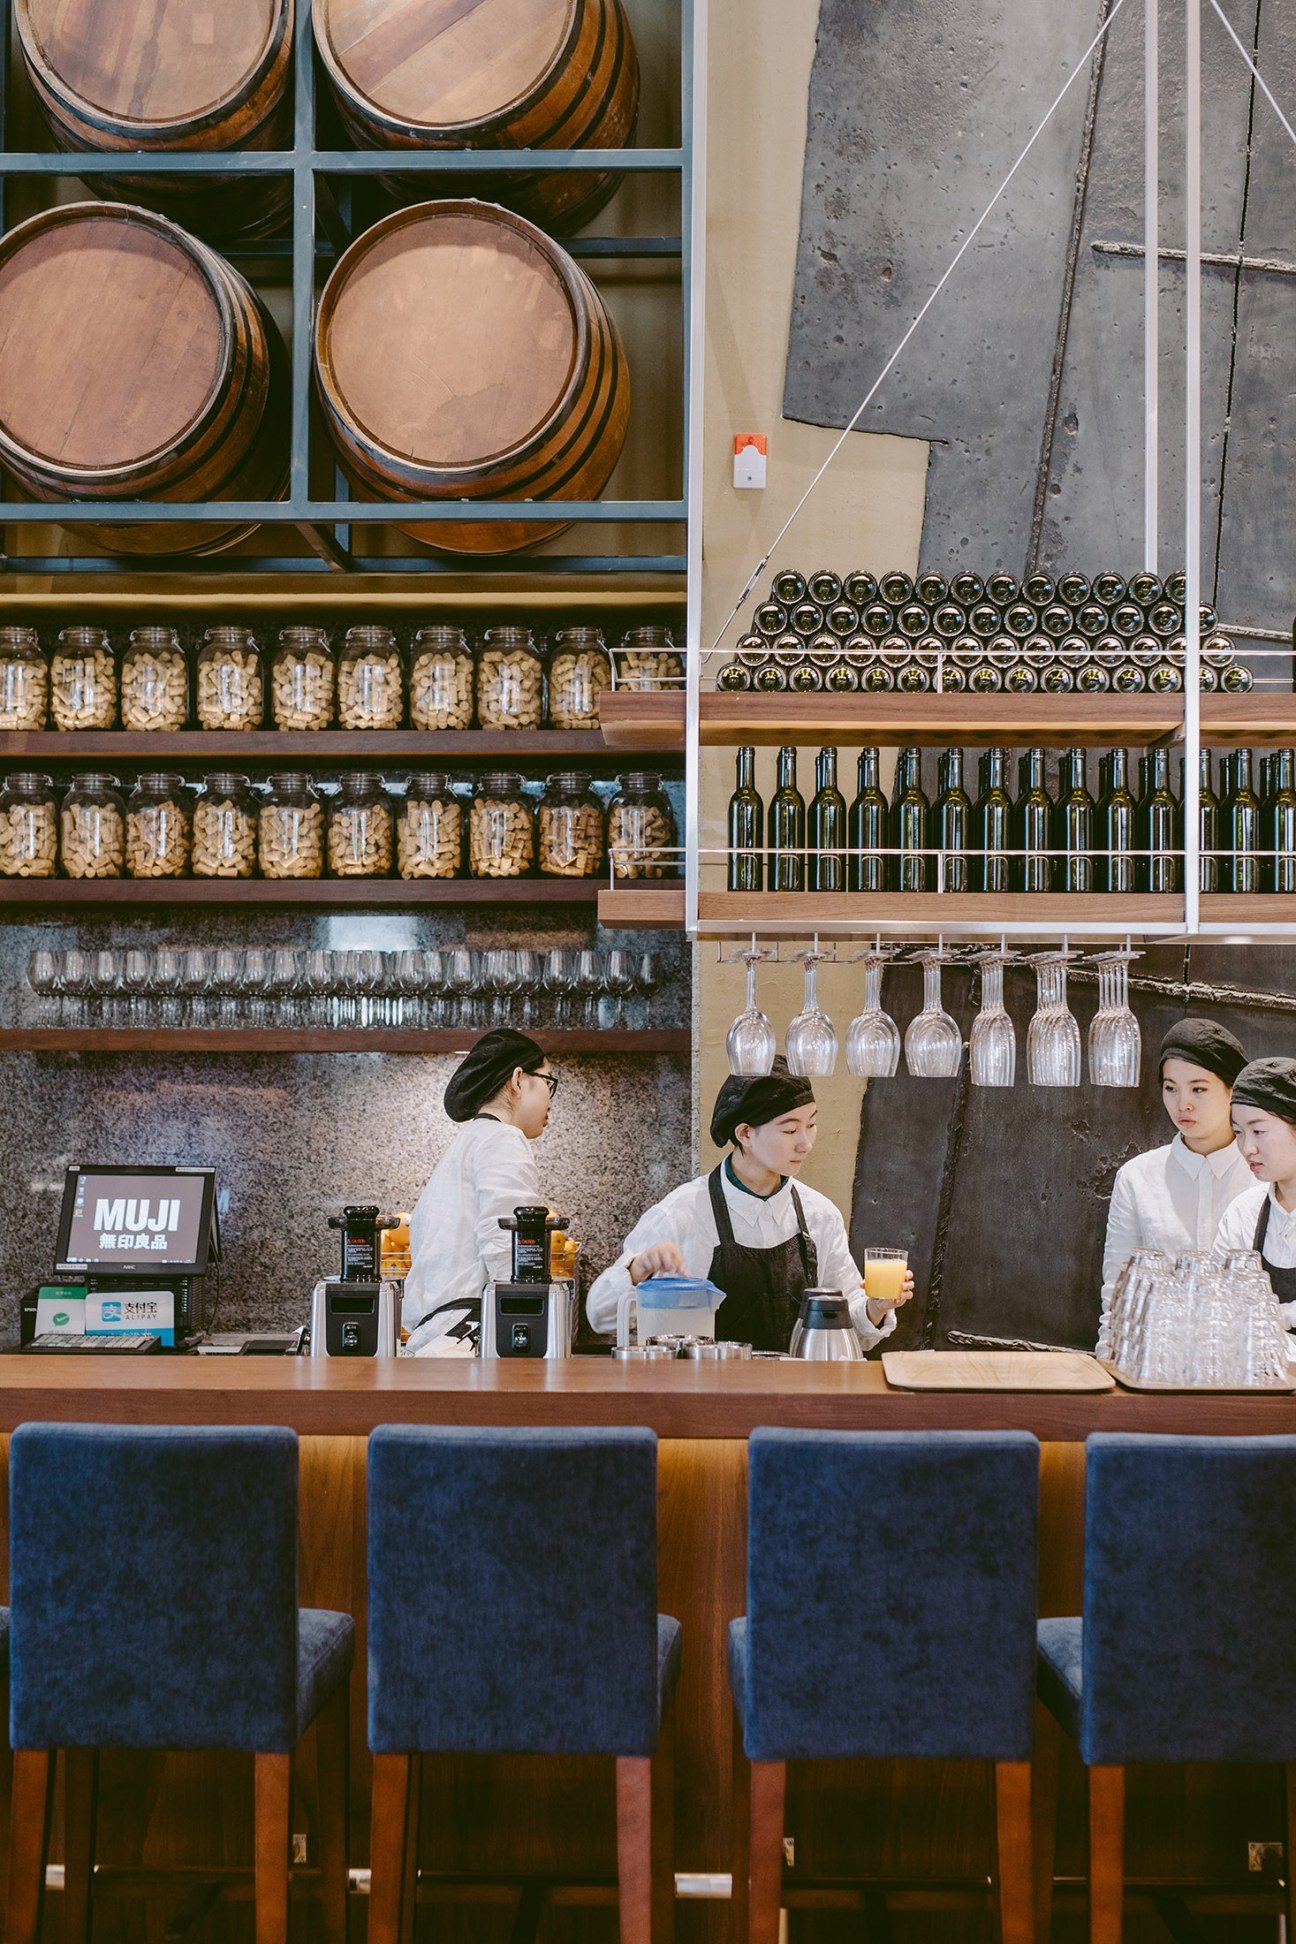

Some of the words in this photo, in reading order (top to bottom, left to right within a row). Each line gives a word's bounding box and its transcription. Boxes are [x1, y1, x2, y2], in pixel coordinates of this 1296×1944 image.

[93, 1198, 181, 1232] MUJI
[99, 1233, 168, 1250] 無印良品
[124, 1301, 158, 1314] 支付宝
